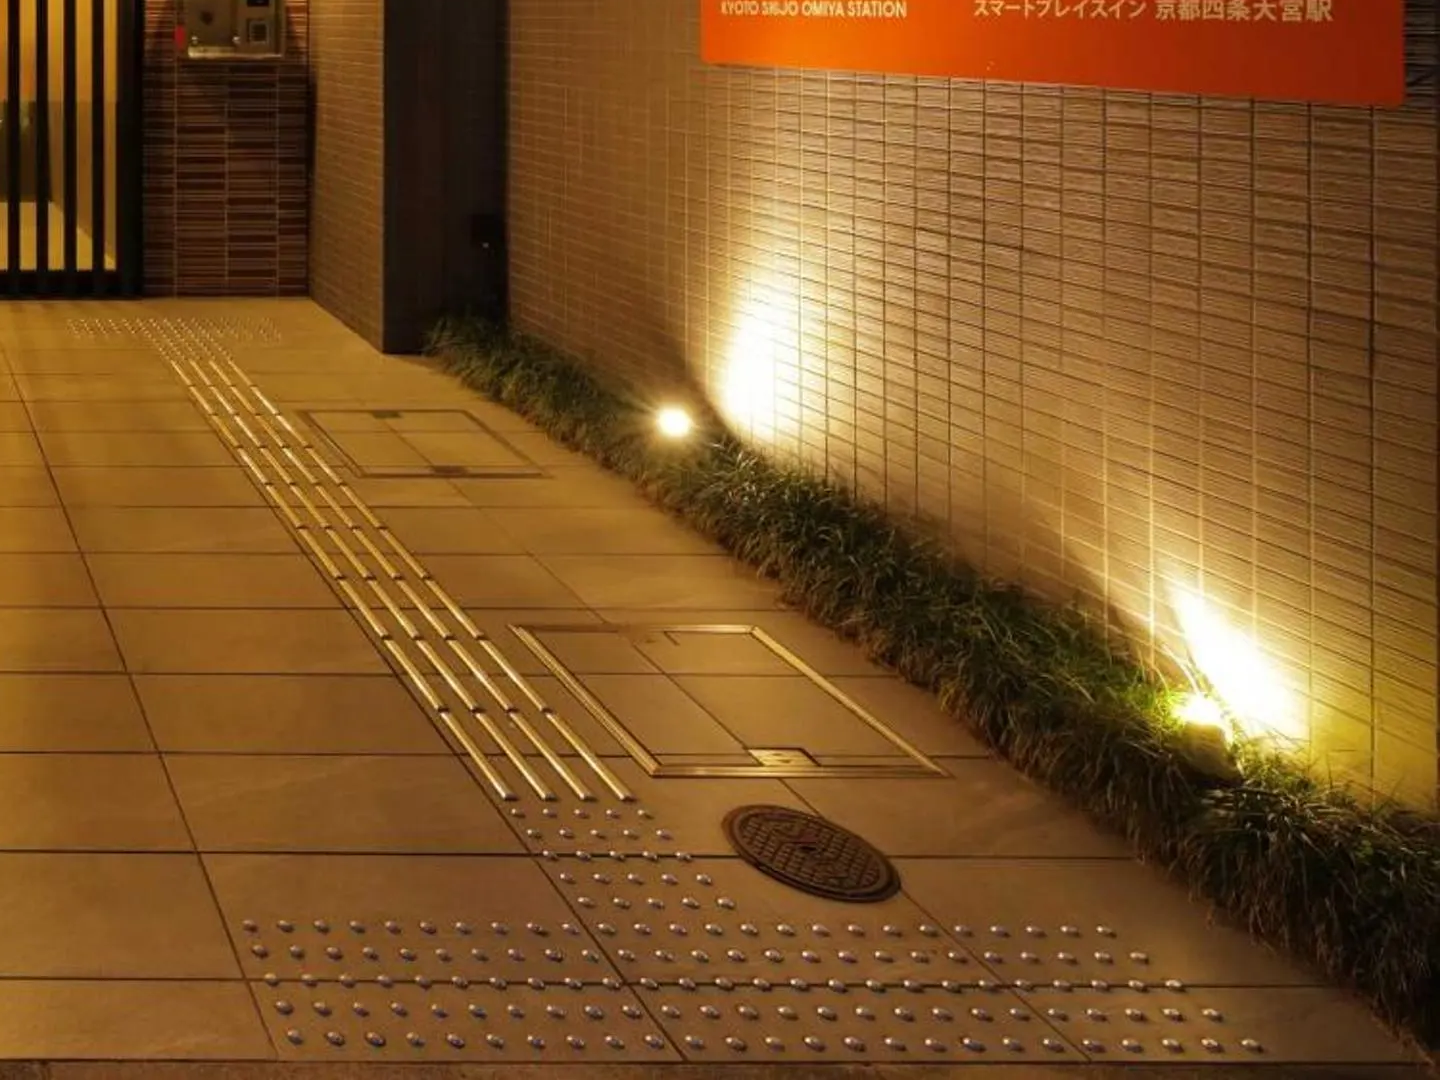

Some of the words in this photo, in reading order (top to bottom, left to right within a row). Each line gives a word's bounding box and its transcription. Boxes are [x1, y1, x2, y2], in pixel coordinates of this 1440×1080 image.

[720, 0, 760, 16] KYOTO
[801, 0, 845, 17] OMIYA
[846, 0, 907, 18] STATION
